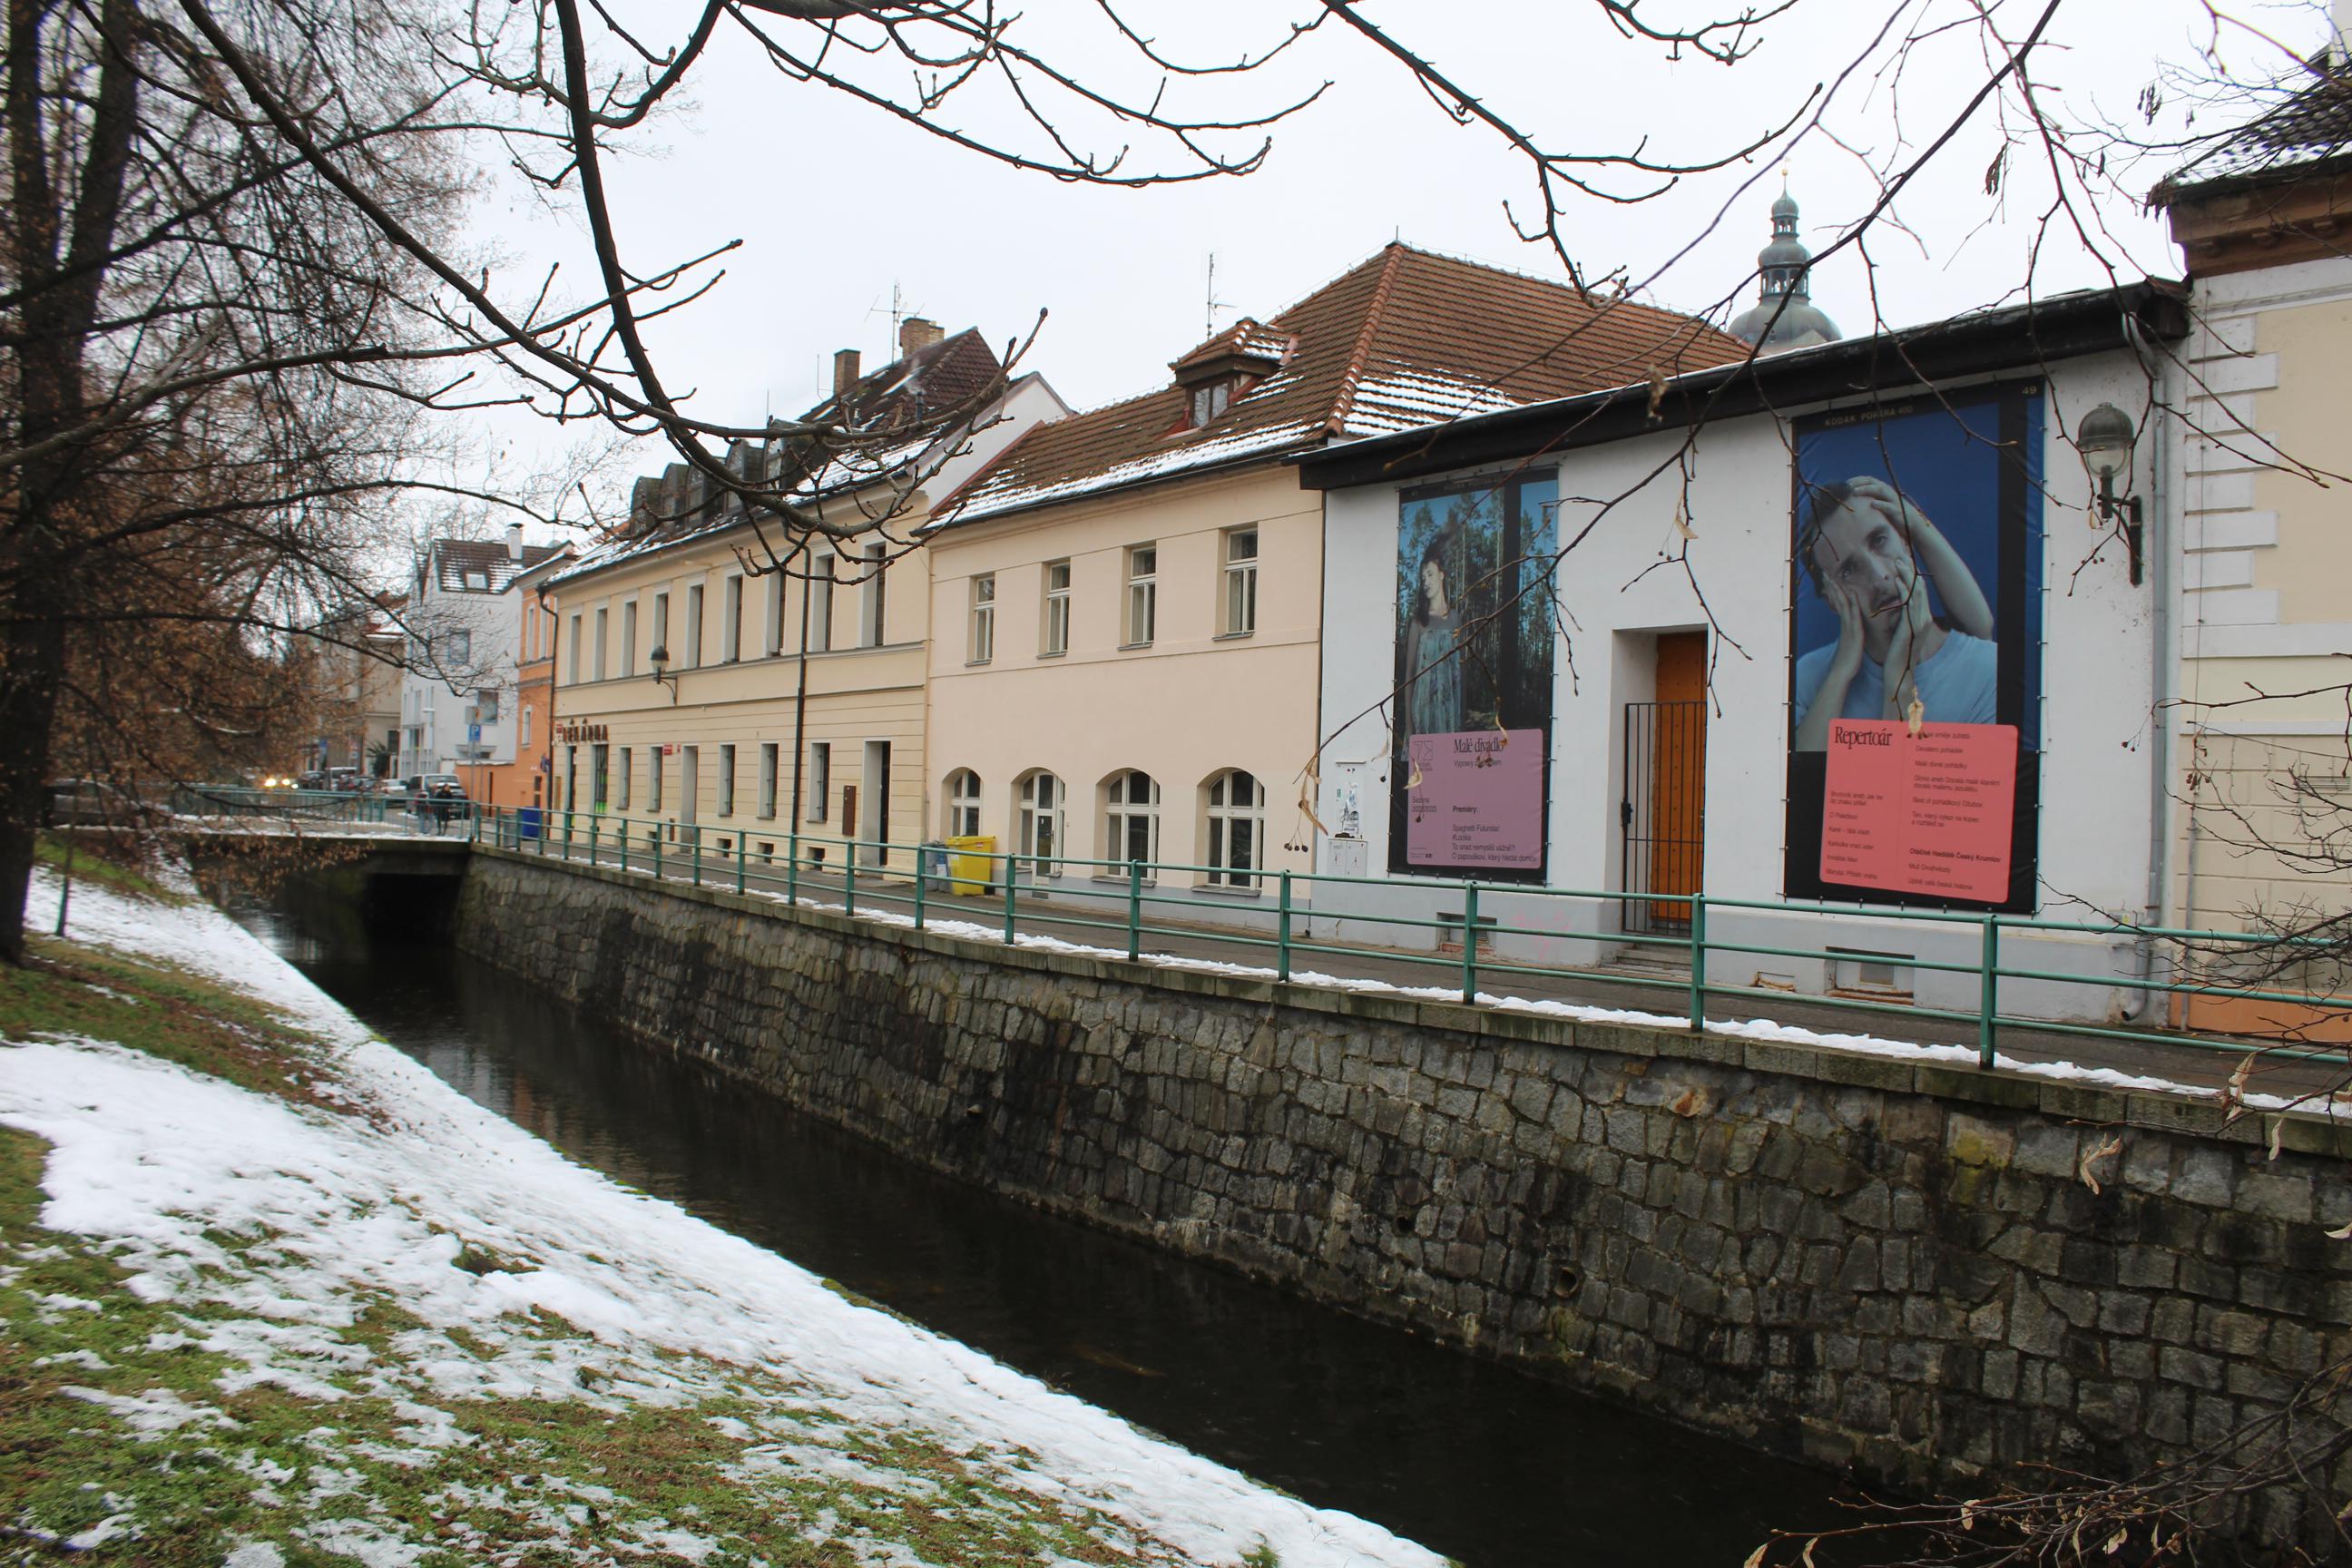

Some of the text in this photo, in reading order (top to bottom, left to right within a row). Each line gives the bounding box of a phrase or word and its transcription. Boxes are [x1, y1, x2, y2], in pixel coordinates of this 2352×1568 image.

[2022, 385, 2037, 396] 49
[1824, 415, 1857, 426] KODAK
[1835, 727, 1892, 749] Repertoár
[1454, 737, 1504, 753] Malé divadlo
